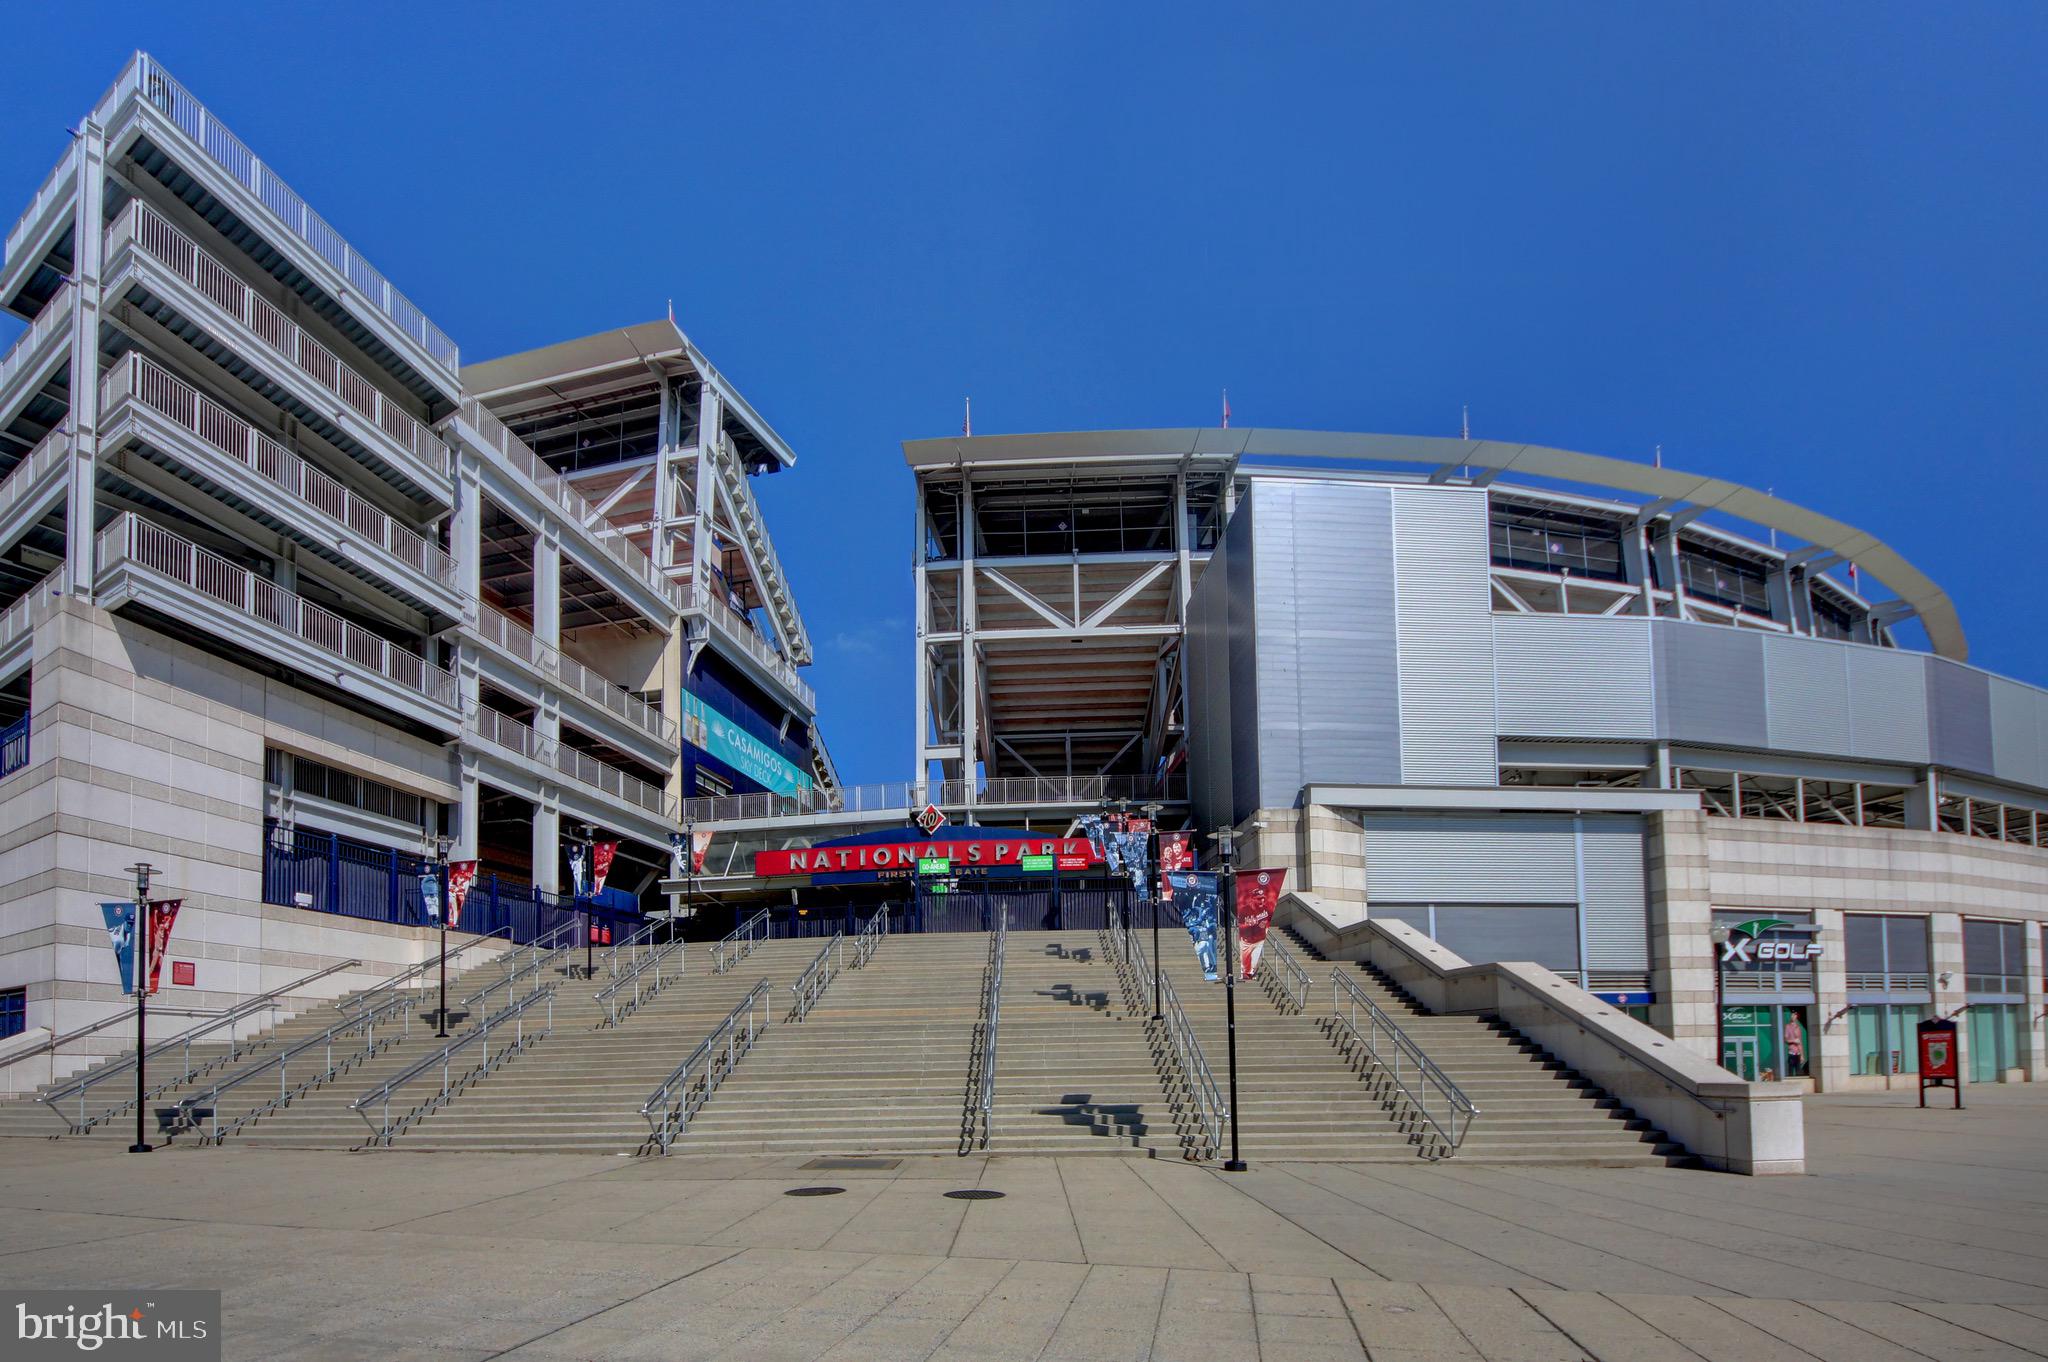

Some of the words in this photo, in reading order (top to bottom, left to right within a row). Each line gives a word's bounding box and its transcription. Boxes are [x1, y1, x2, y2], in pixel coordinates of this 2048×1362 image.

[727, 729, 783, 776] CASAMIGOS
[740, 755, 752, 773] SKY
[754, 764, 772, 784] DECK
[789, 843, 982, 870] NATIONALS
[995, 841, 1079, 861] PARK
[877, 870, 915, 879] FIRST
[955, 867, 989, 876] GATE
[1757, 943, 1824, 960] GOLF
